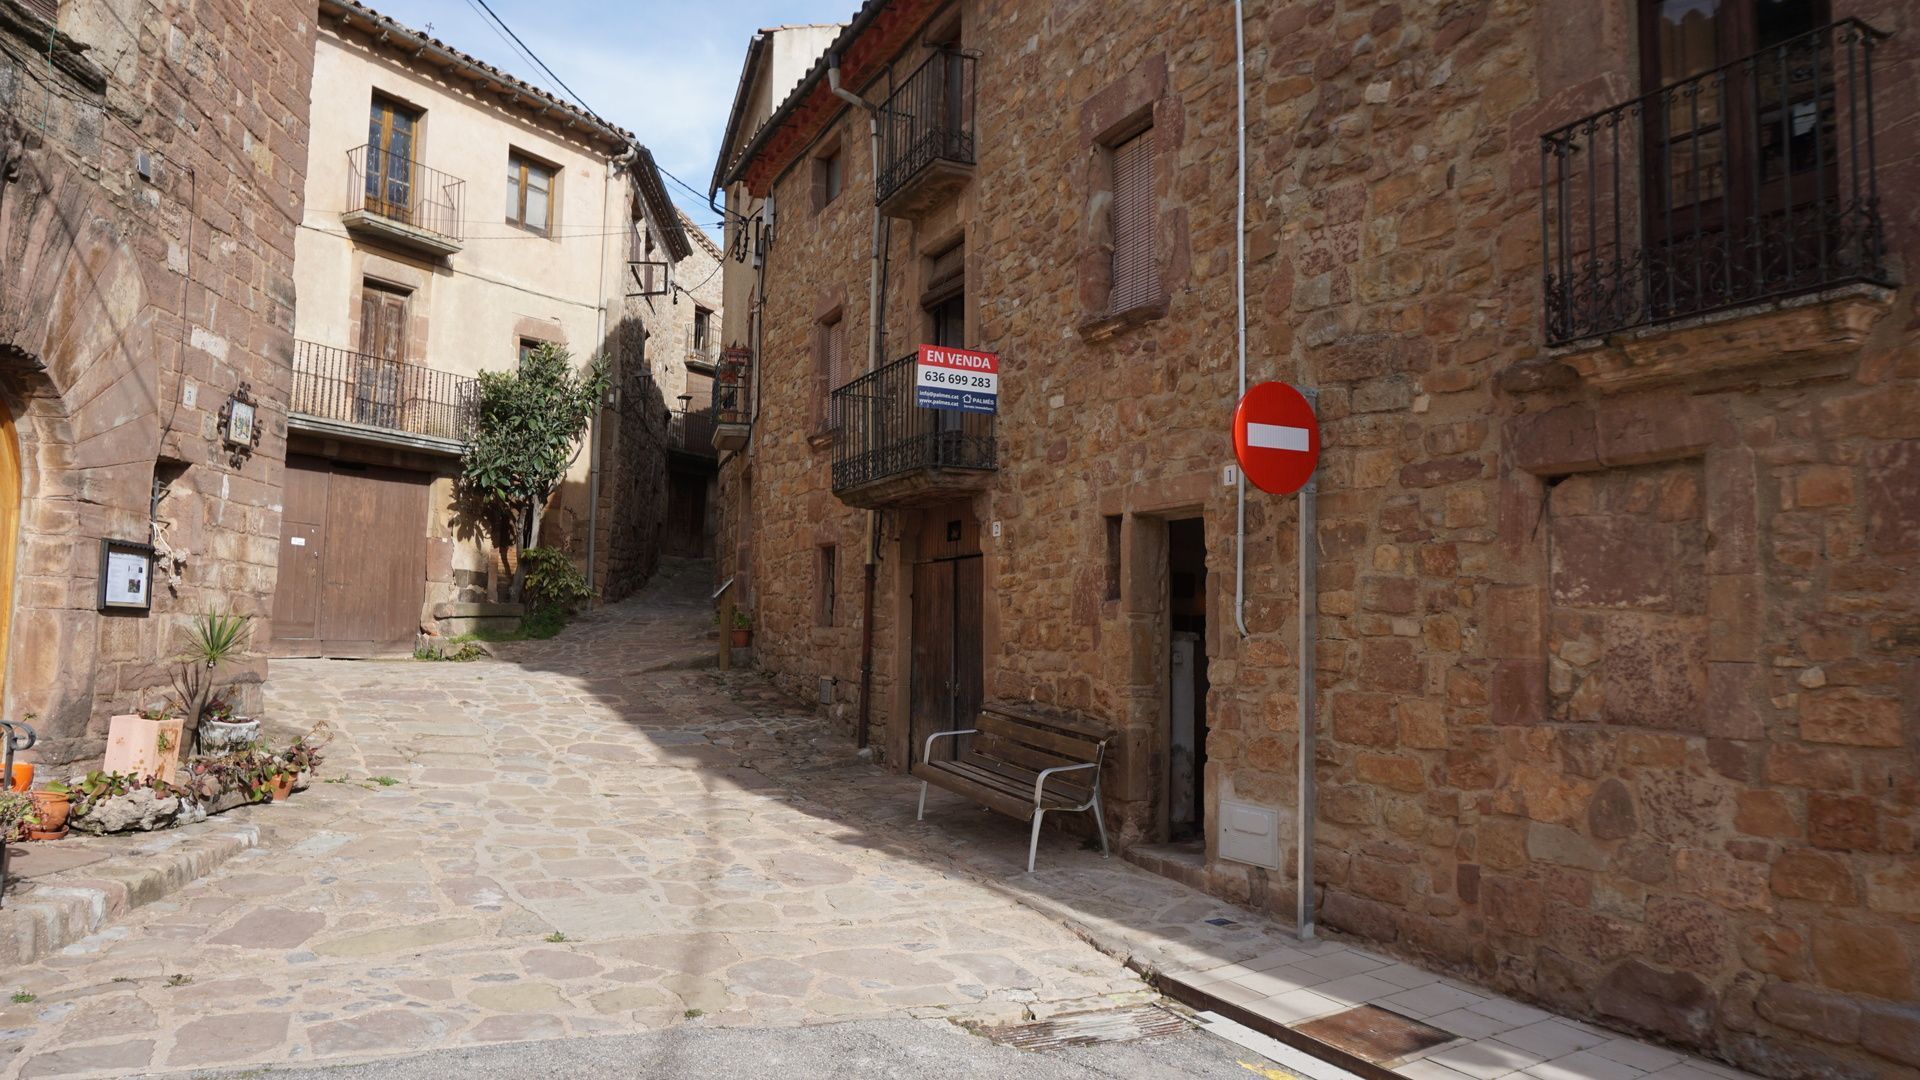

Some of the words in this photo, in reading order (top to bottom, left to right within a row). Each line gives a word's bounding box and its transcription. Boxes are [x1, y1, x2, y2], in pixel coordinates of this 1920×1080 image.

[927, 350, 944, 363] EN
[948, 353, 991, 369] VENDA
[925, 371, 945, 382] 636
[948, 374, 968, 385] 699
[971, 377, 991, 388] 283
[919, 390, 959, 399] info@palmes.cat
[919, 398, 959, 406] www.palmes.cat
[1228, 470, 1232, 482] 1
